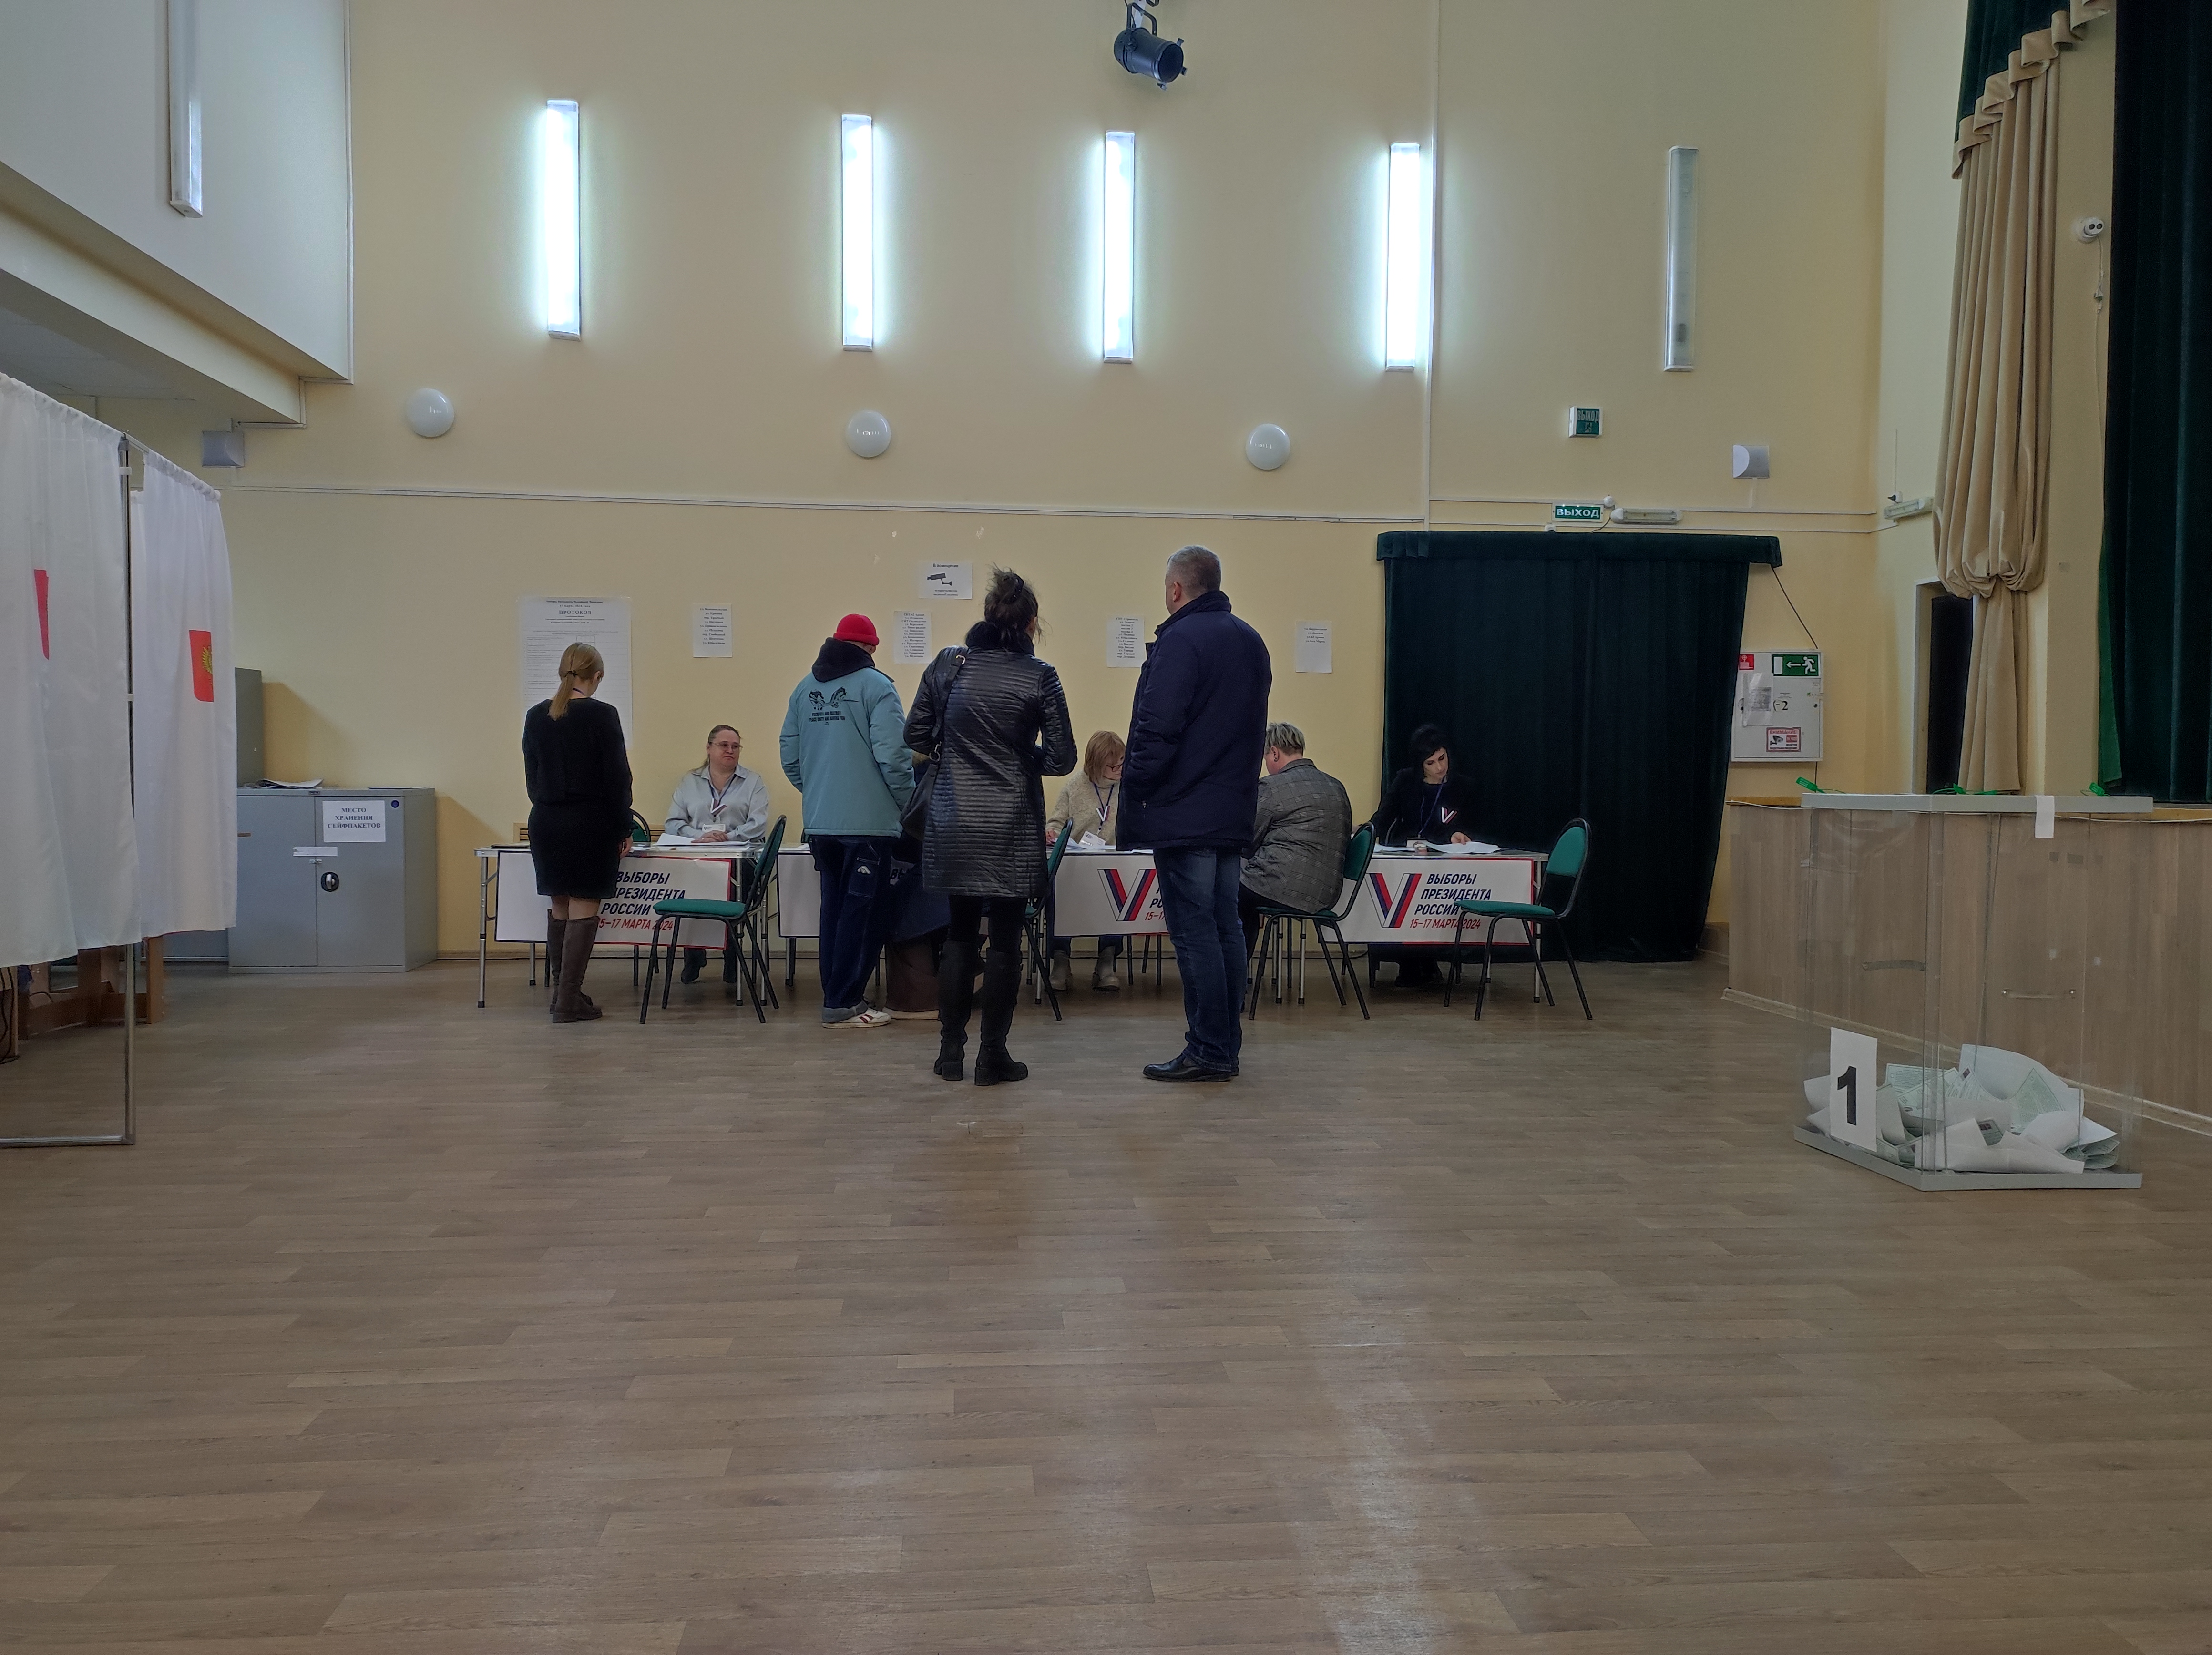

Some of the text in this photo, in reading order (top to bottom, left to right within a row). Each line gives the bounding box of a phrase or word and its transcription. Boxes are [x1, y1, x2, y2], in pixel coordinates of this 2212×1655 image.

[1577, 410, 1599, 423] ВЫХОД
[1557, 508, 1599, 518] ВЫХОД
[616, 871, 670, 884] ВЫБОРЫ
[1426, 873, 1477, 885] ВЫБОРЫ
[1420, 889, 1492, 901] ПРЕЗИДЕНТА
[601, 903, 652, 915] РОССИИ
[1414, 904, 1460, 915] РОССИИ
[599, 918, 673, 930] 5–17 МАРТА 224
[1432, 919, 1460, 929] МАРТА
[1462, 919, 1481, 929] 2024
[1837, 1066, 1856, 1125] 1
